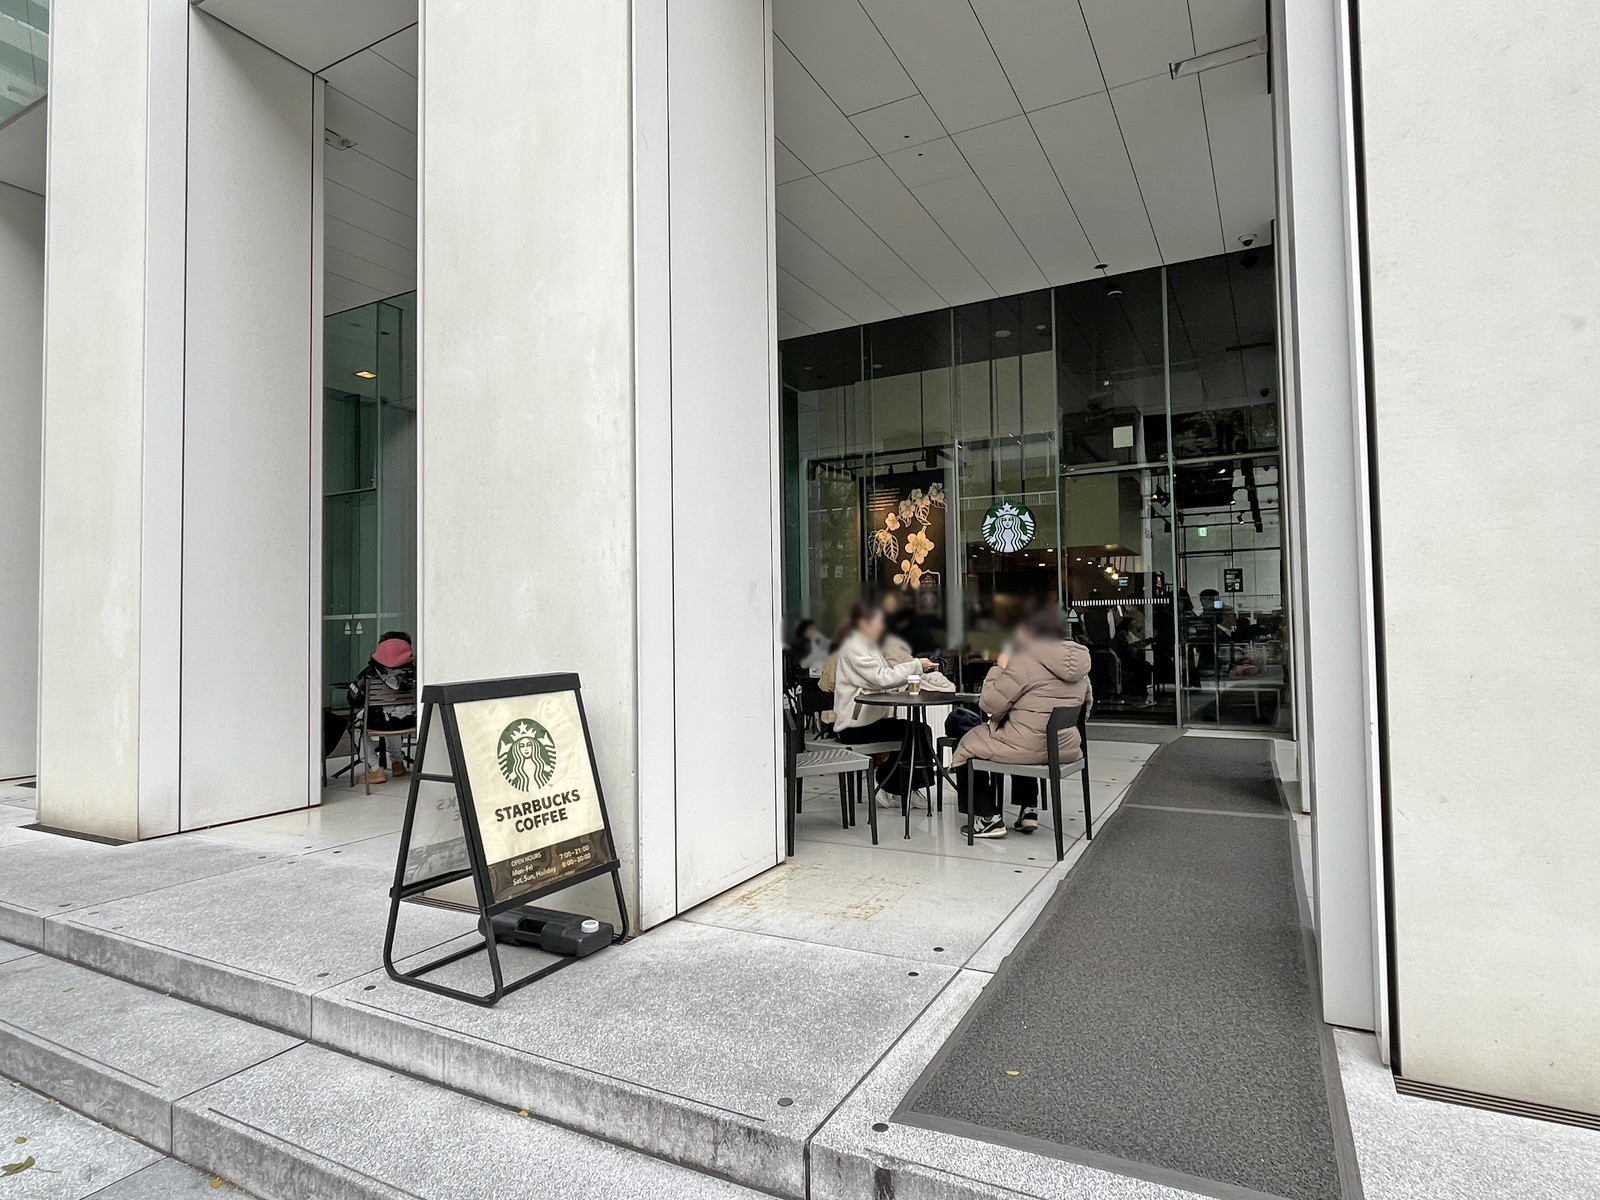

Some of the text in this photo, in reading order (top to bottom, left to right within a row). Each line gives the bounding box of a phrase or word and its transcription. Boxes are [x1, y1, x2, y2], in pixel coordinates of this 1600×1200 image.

[495, 789, 580, 822] STARBUCKS
[515, 808, 568, 833] COFFEE
[511, 852, 542, 867] OPEN HOURS
[512, 864, 534, 877] Mon-Fri
[536, 866, 556, 878] Holiday
